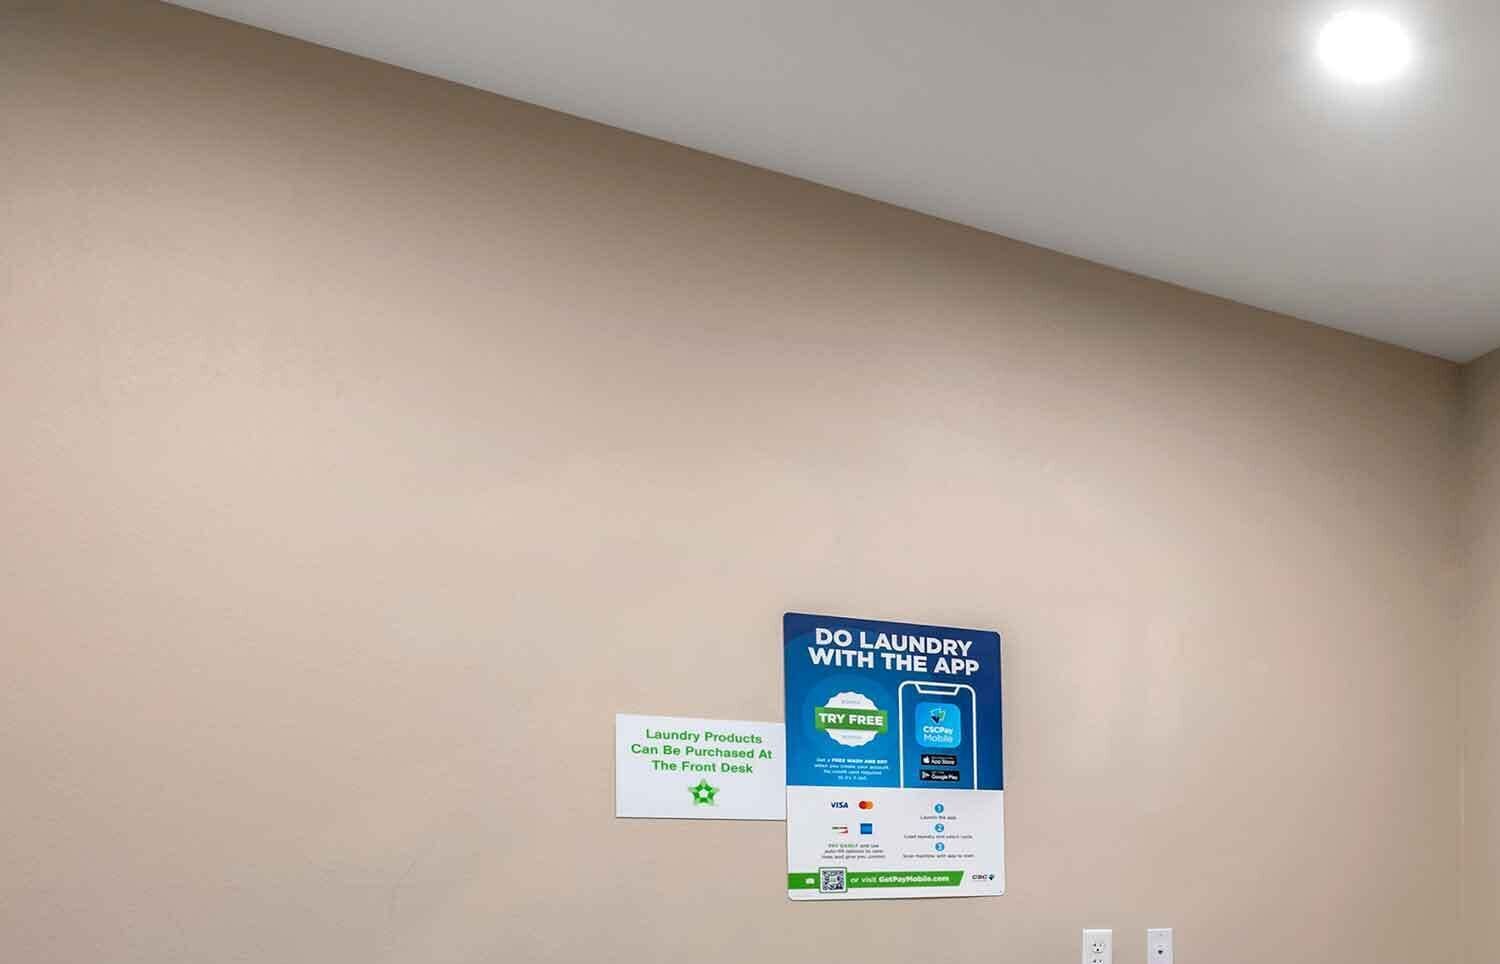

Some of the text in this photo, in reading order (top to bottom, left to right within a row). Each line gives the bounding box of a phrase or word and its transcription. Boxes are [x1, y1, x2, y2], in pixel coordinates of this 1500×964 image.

[815, 627, 973, 657] DO LAUNDRY
[807, 646, 980, 676] WITH THE APP
[818, 712, 884, 726] TRY FREE
[645, 728, 763, 744] Laundry Products
[922, 725, 954, 735] CSCPay
[923, 734, 953, 743] Mobile
[631, 743, 773, 760] Can Be Purchased At
[651, 760, 753, 773] The Front Desk
[878, 875, 950, 884] GetPayMobile.com
